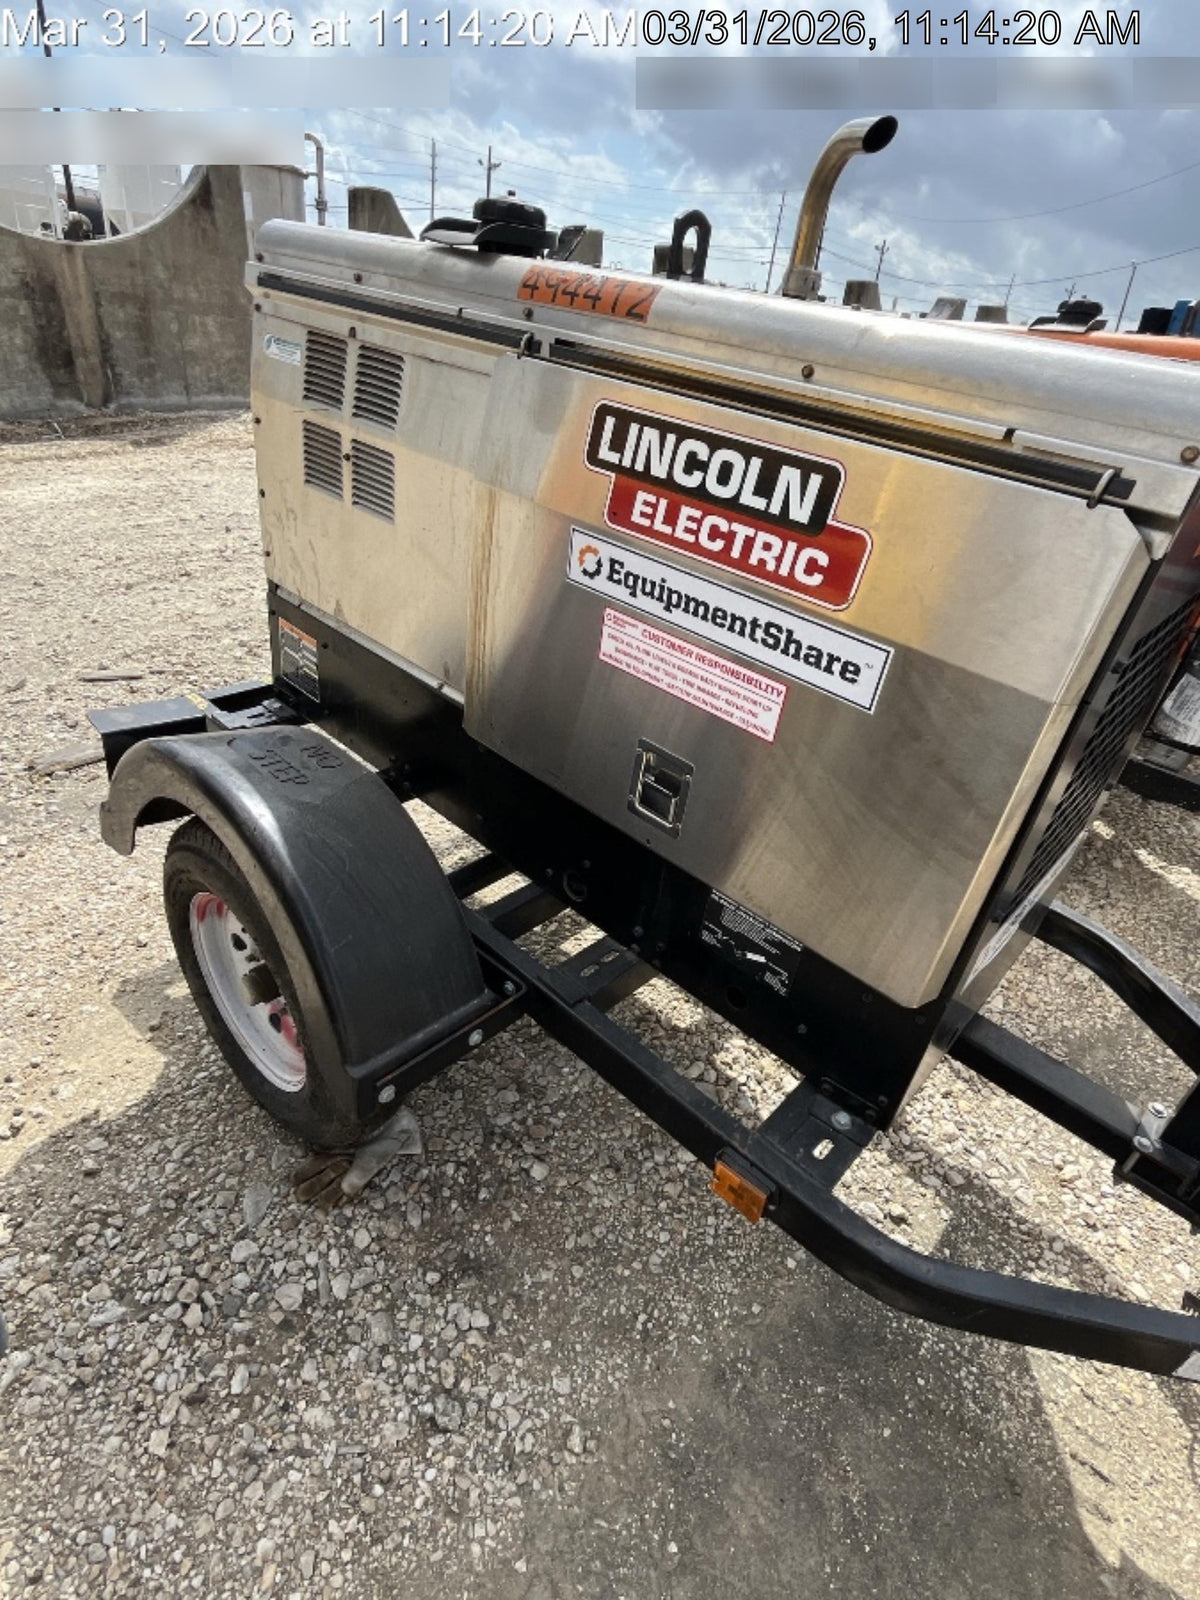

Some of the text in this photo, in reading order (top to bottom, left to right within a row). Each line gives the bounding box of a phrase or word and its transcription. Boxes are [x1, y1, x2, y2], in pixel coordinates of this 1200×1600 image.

[597, 415, 824, 525] LINCOLN
[630, 490, 830, 588] ELECTRIC
[606, 557, 863, 686] EquipmentShare
[642, 628, 694, 658] CUSTOMER
[694, 652, 784, 698] RESPONSIBILITY
[248, 748, 310, 785] STEP
